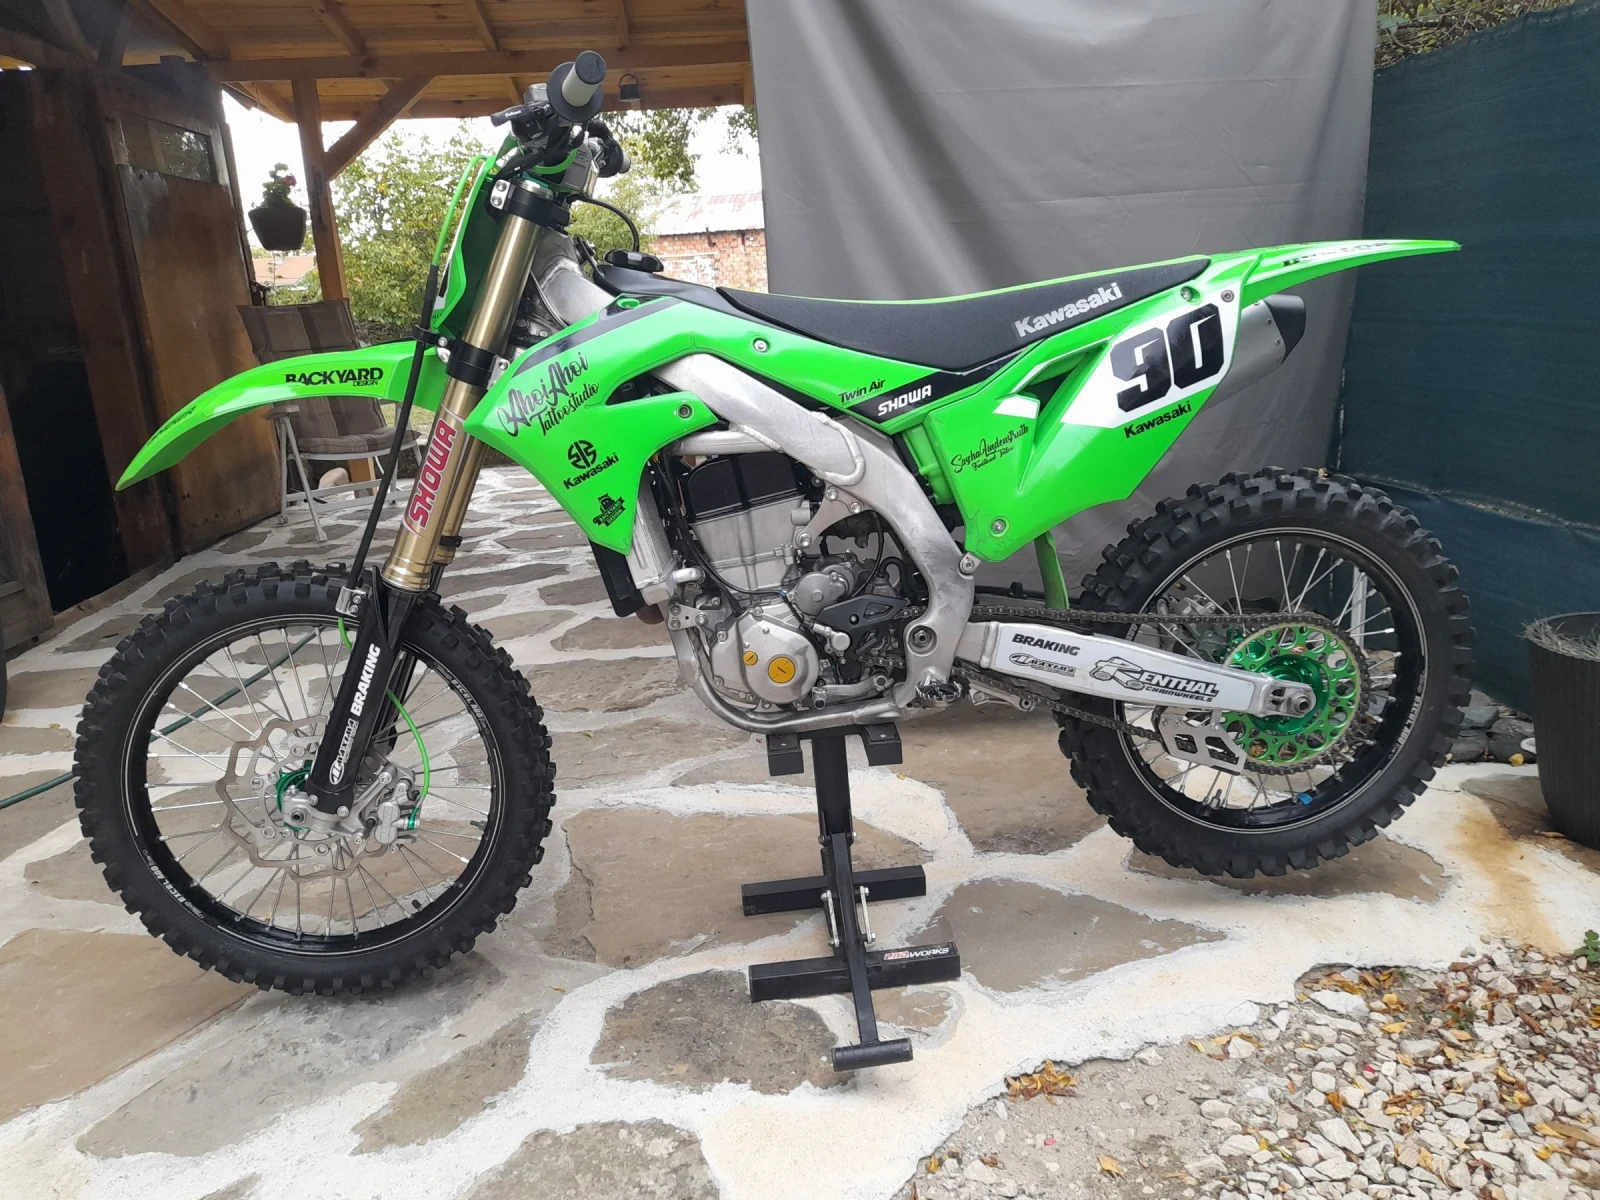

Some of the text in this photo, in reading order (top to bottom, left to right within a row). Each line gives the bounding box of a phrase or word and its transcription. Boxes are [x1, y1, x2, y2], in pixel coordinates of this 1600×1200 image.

[1014, 283, 1123, 338] Kawasaki
[285, 367, 384, 386] BACKYARD
[1110, 303, 1225, 413] 90
[529, 382, 600, 436] Tattoostudio
[839, 387, 867, 403] Twin
[869, 379, 886, 392] Air
[877, 384, 932, 417] SHOWA
[1124, 400, 1192, 439] Kawasaki
[407, 419, 457, 529] SHOWA
[563, 452, 619, 490] Kawasaki
[1011, 633, 1081, 656] BRAKING
[350, 643, 381, 717] BRAKING
[1145, 685, 1213, 703] CHAINWHEELS
